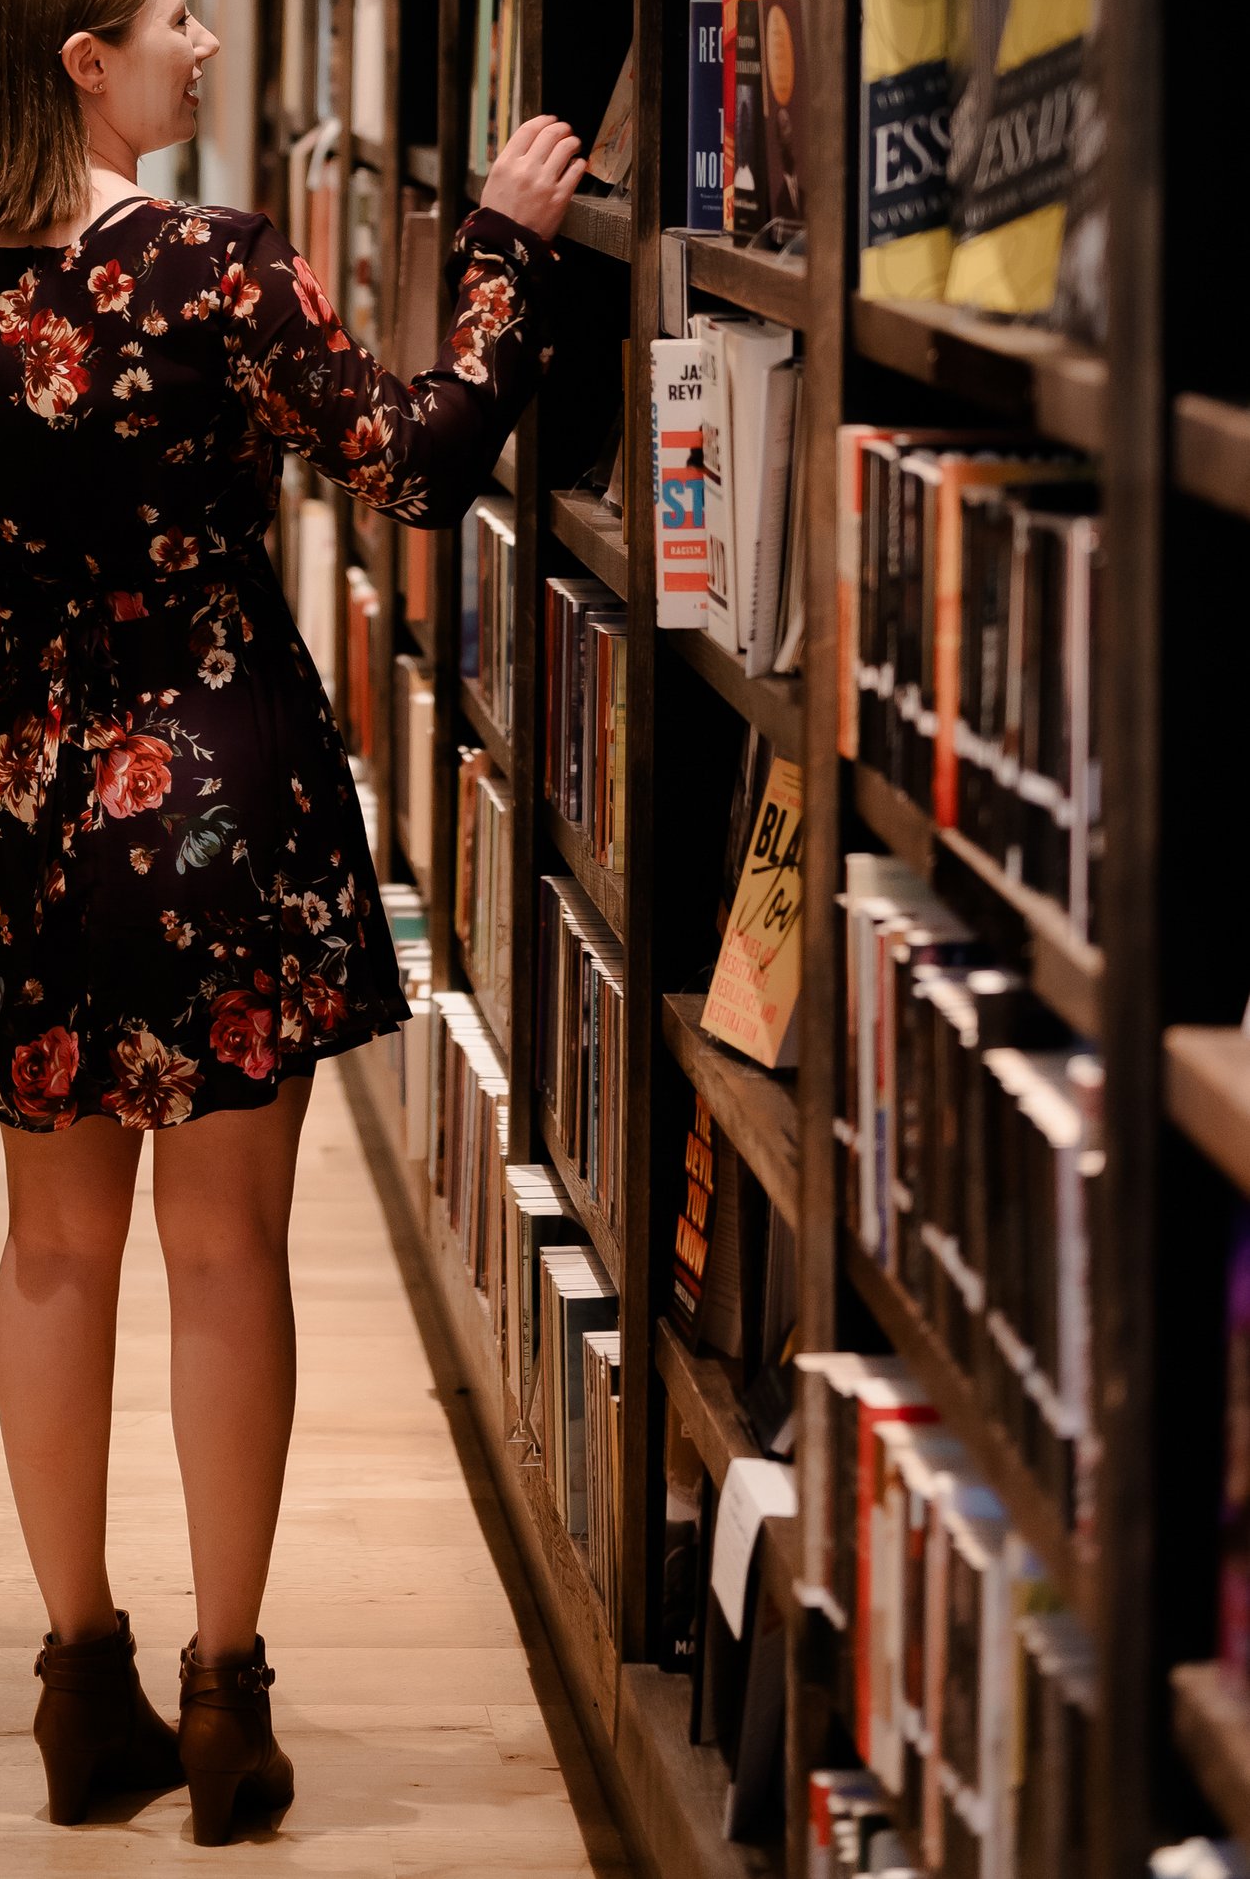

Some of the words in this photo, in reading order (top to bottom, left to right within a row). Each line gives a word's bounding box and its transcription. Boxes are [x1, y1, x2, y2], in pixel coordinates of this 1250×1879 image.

[662, 478, 705, 528] ST
[753, 802, 803, 872] BLA
[706, 999, 757, 1042] RESTORATION
[685, 1131, 713, 1195] DEVIL
[686, 1177, 709, 1234] YOU
[675, 1213, 708, 1281] KNOW
[675, 1639, 695, 1655] MA
